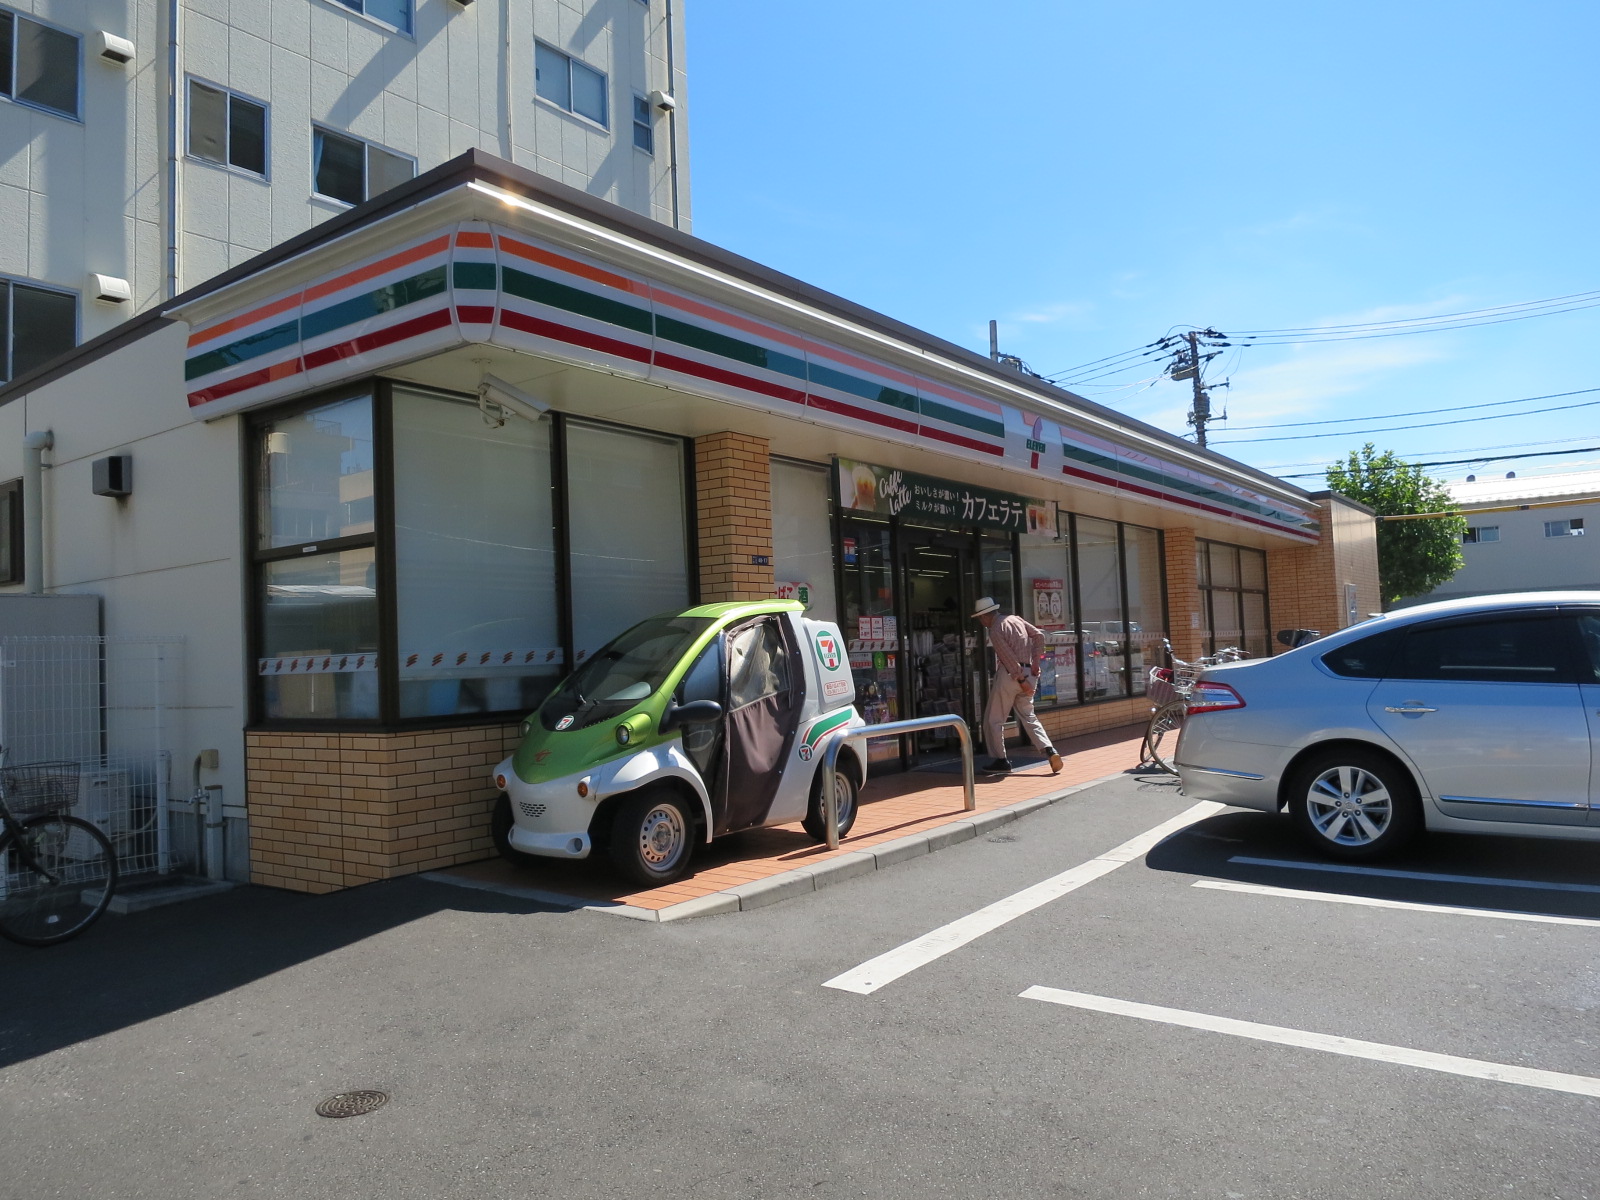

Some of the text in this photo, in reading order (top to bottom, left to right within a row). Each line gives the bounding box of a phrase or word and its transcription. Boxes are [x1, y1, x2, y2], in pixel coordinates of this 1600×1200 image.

[889, 484, 912, 516] Latte
[961, 491, 1023, 528] カフェラテ
[798, 586, 809, 604] 酒
[820, 639, 835, 668] 7
